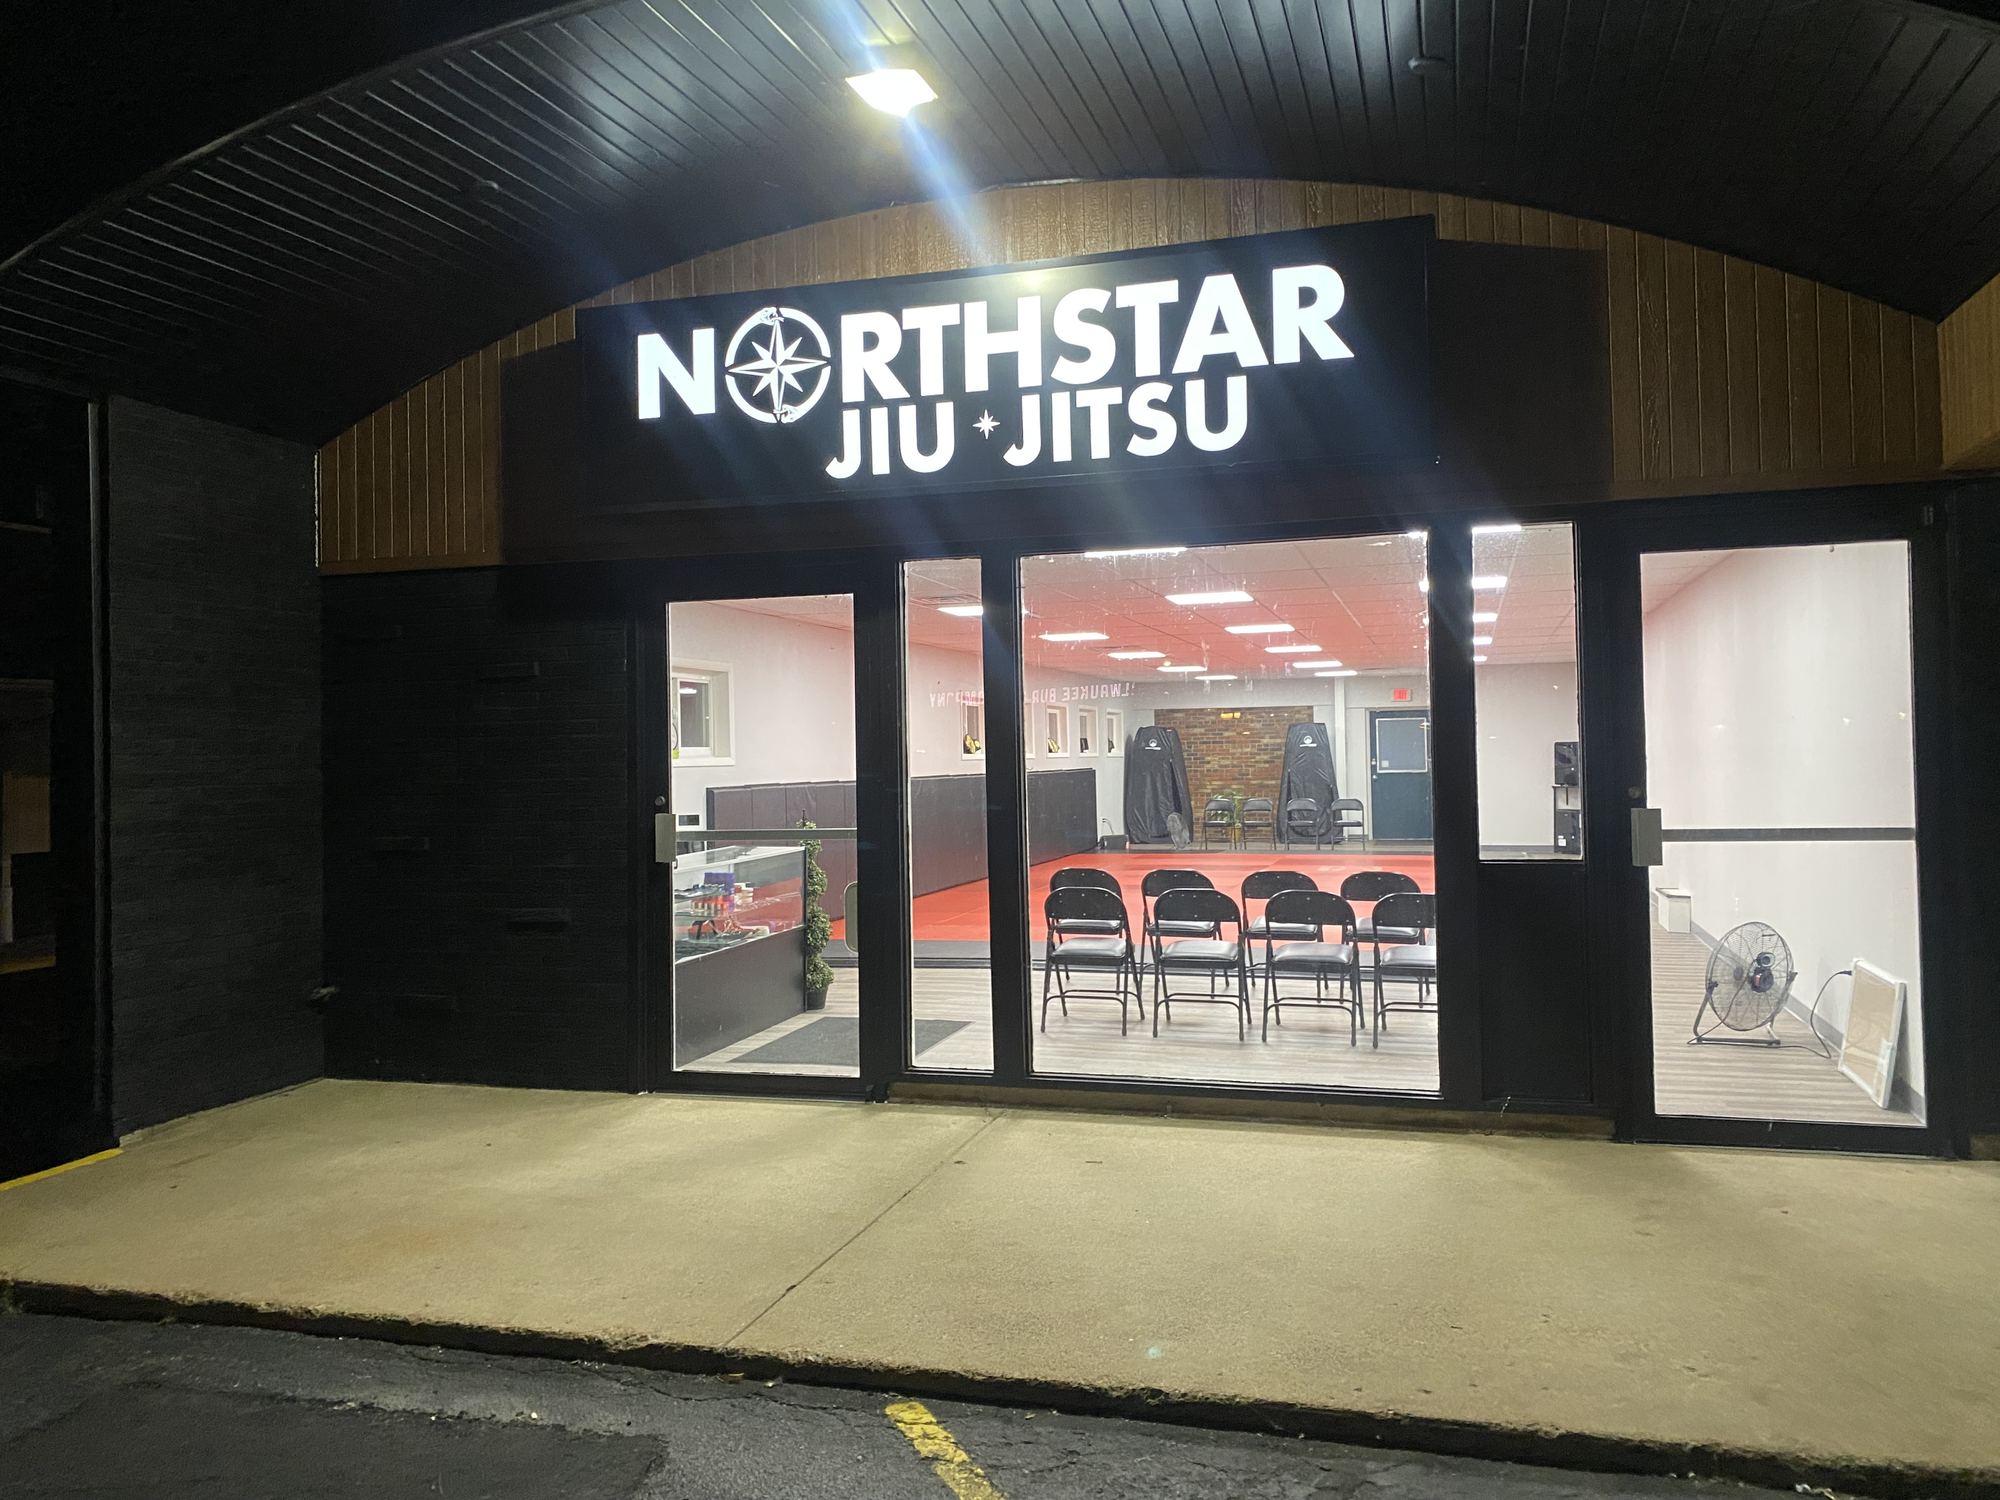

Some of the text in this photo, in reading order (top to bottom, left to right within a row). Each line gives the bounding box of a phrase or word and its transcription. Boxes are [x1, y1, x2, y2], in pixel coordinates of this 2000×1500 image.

[636, 264, 1355, 423] NORTHSTAR
[825, 375, 1249, 480] JIU JITSU
